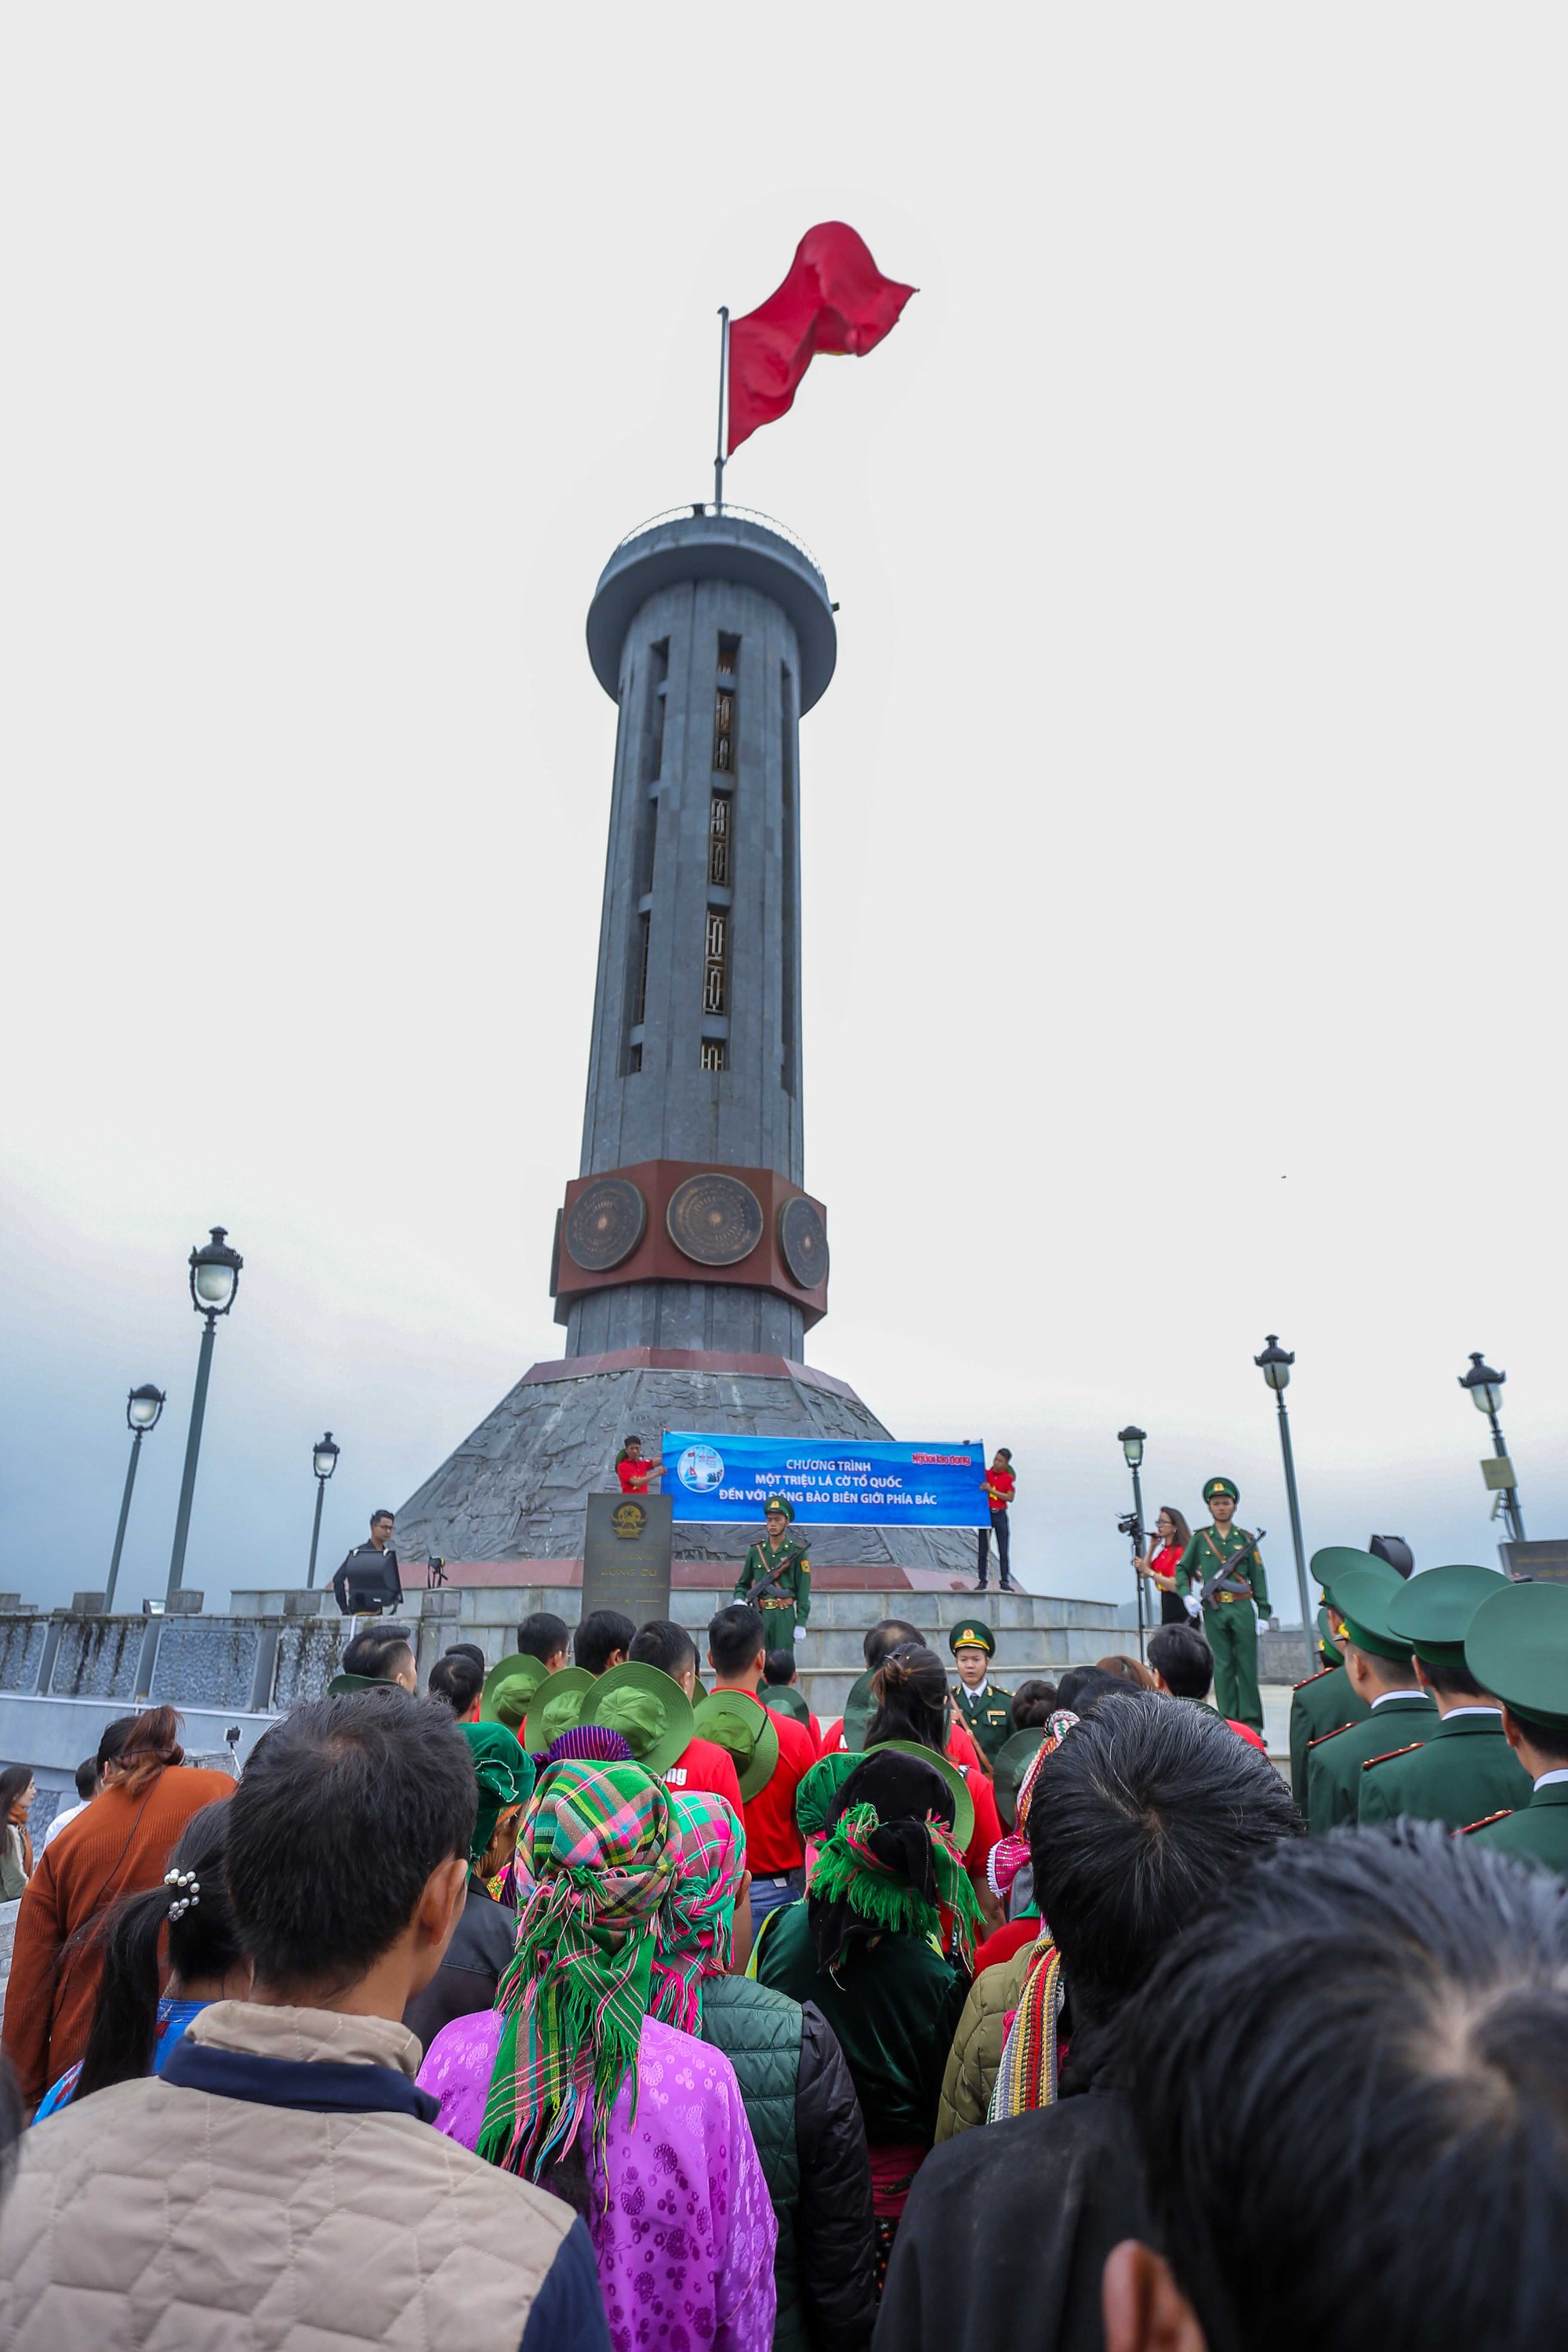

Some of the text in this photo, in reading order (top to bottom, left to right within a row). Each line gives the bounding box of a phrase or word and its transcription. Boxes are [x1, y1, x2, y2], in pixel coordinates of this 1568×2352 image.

[786, 1459, 871, 1472] CHƯƠNG TRÌNH
[755, 1473, 902, 1488] MỘT TRIỆU LÁ CỜ TỔ QUỐC
[719, 1486, 744, 1500] ĐẾN
[745, 1488, 766, 1501] VỚI
[806, 1490, 830, 1502] BÀO
[832, 1491, 858, 1503] BIÊN
[860, 1492, 884, 1504] GIỚI
[887, 1492, 913, 1504] PHÍA
[915, 1492, 938, 1504] BẮC
